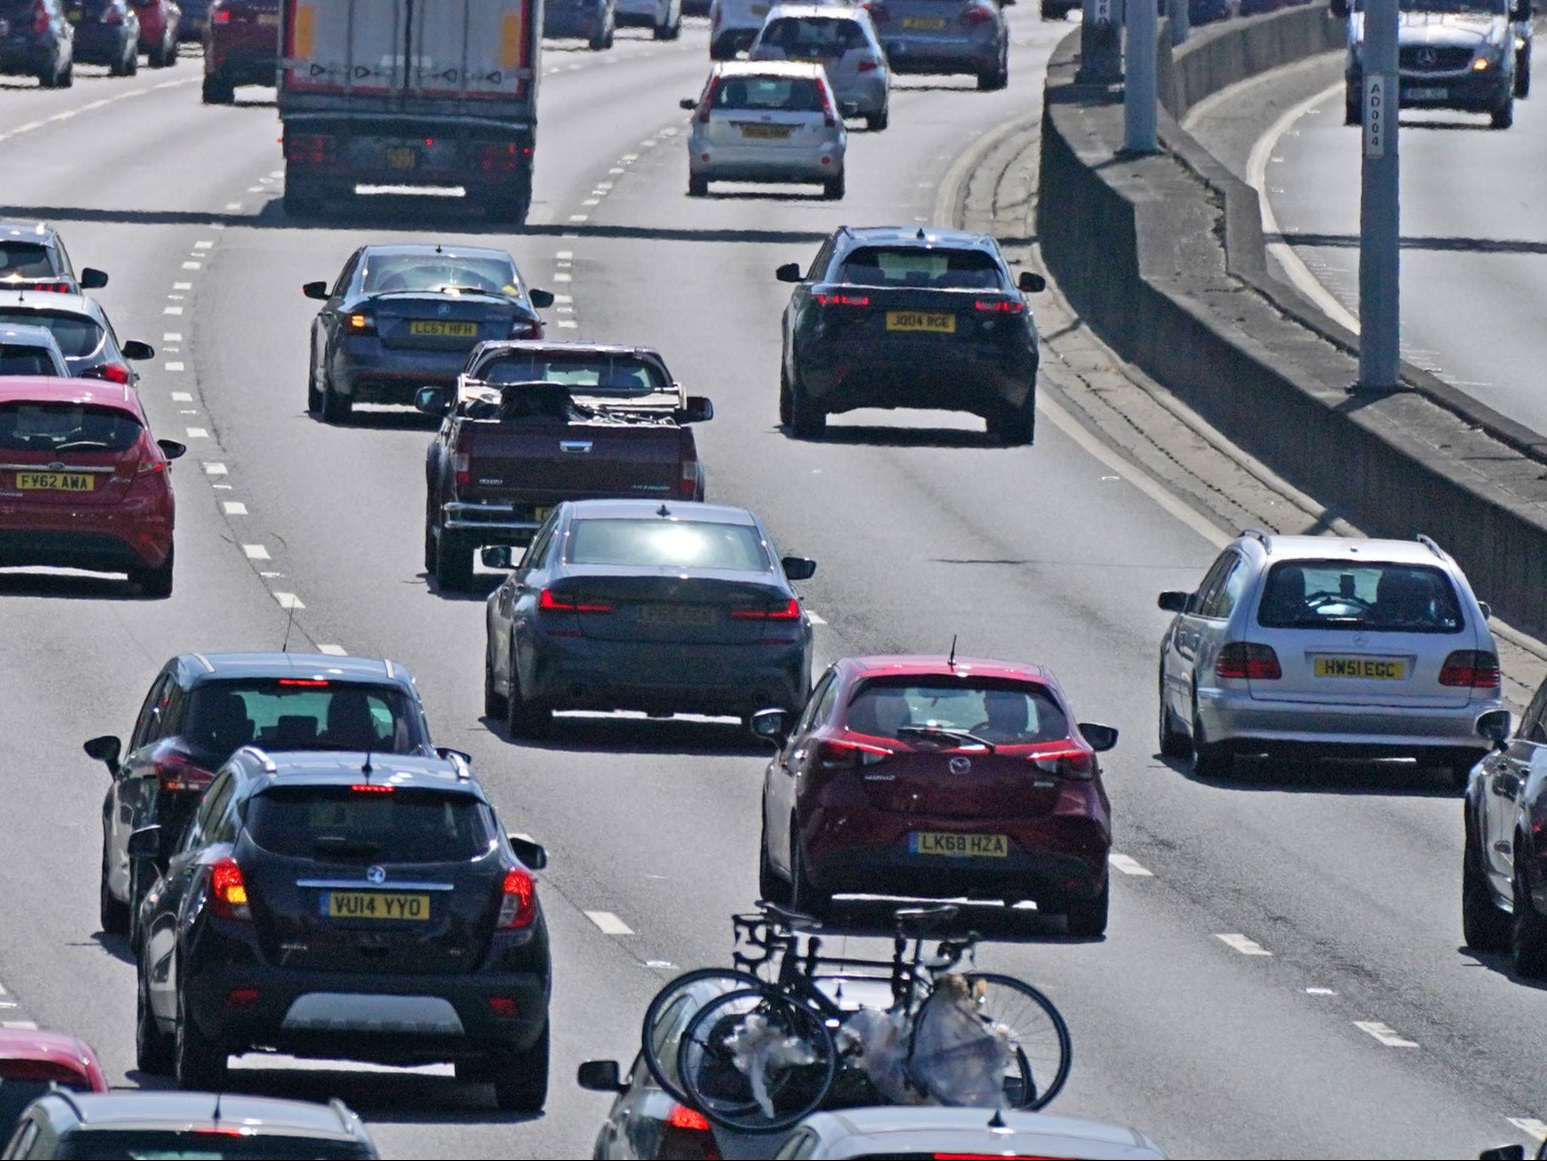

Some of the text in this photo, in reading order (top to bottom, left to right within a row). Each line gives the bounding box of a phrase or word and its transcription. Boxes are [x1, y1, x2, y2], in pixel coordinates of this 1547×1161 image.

[61, 476, 88, 489] AWA
[1324, 660, 1395, 677] HW51 EGC
[922, 835, 1003, 854] LK68 HZA
[335, 896, 376, 914] VU14
